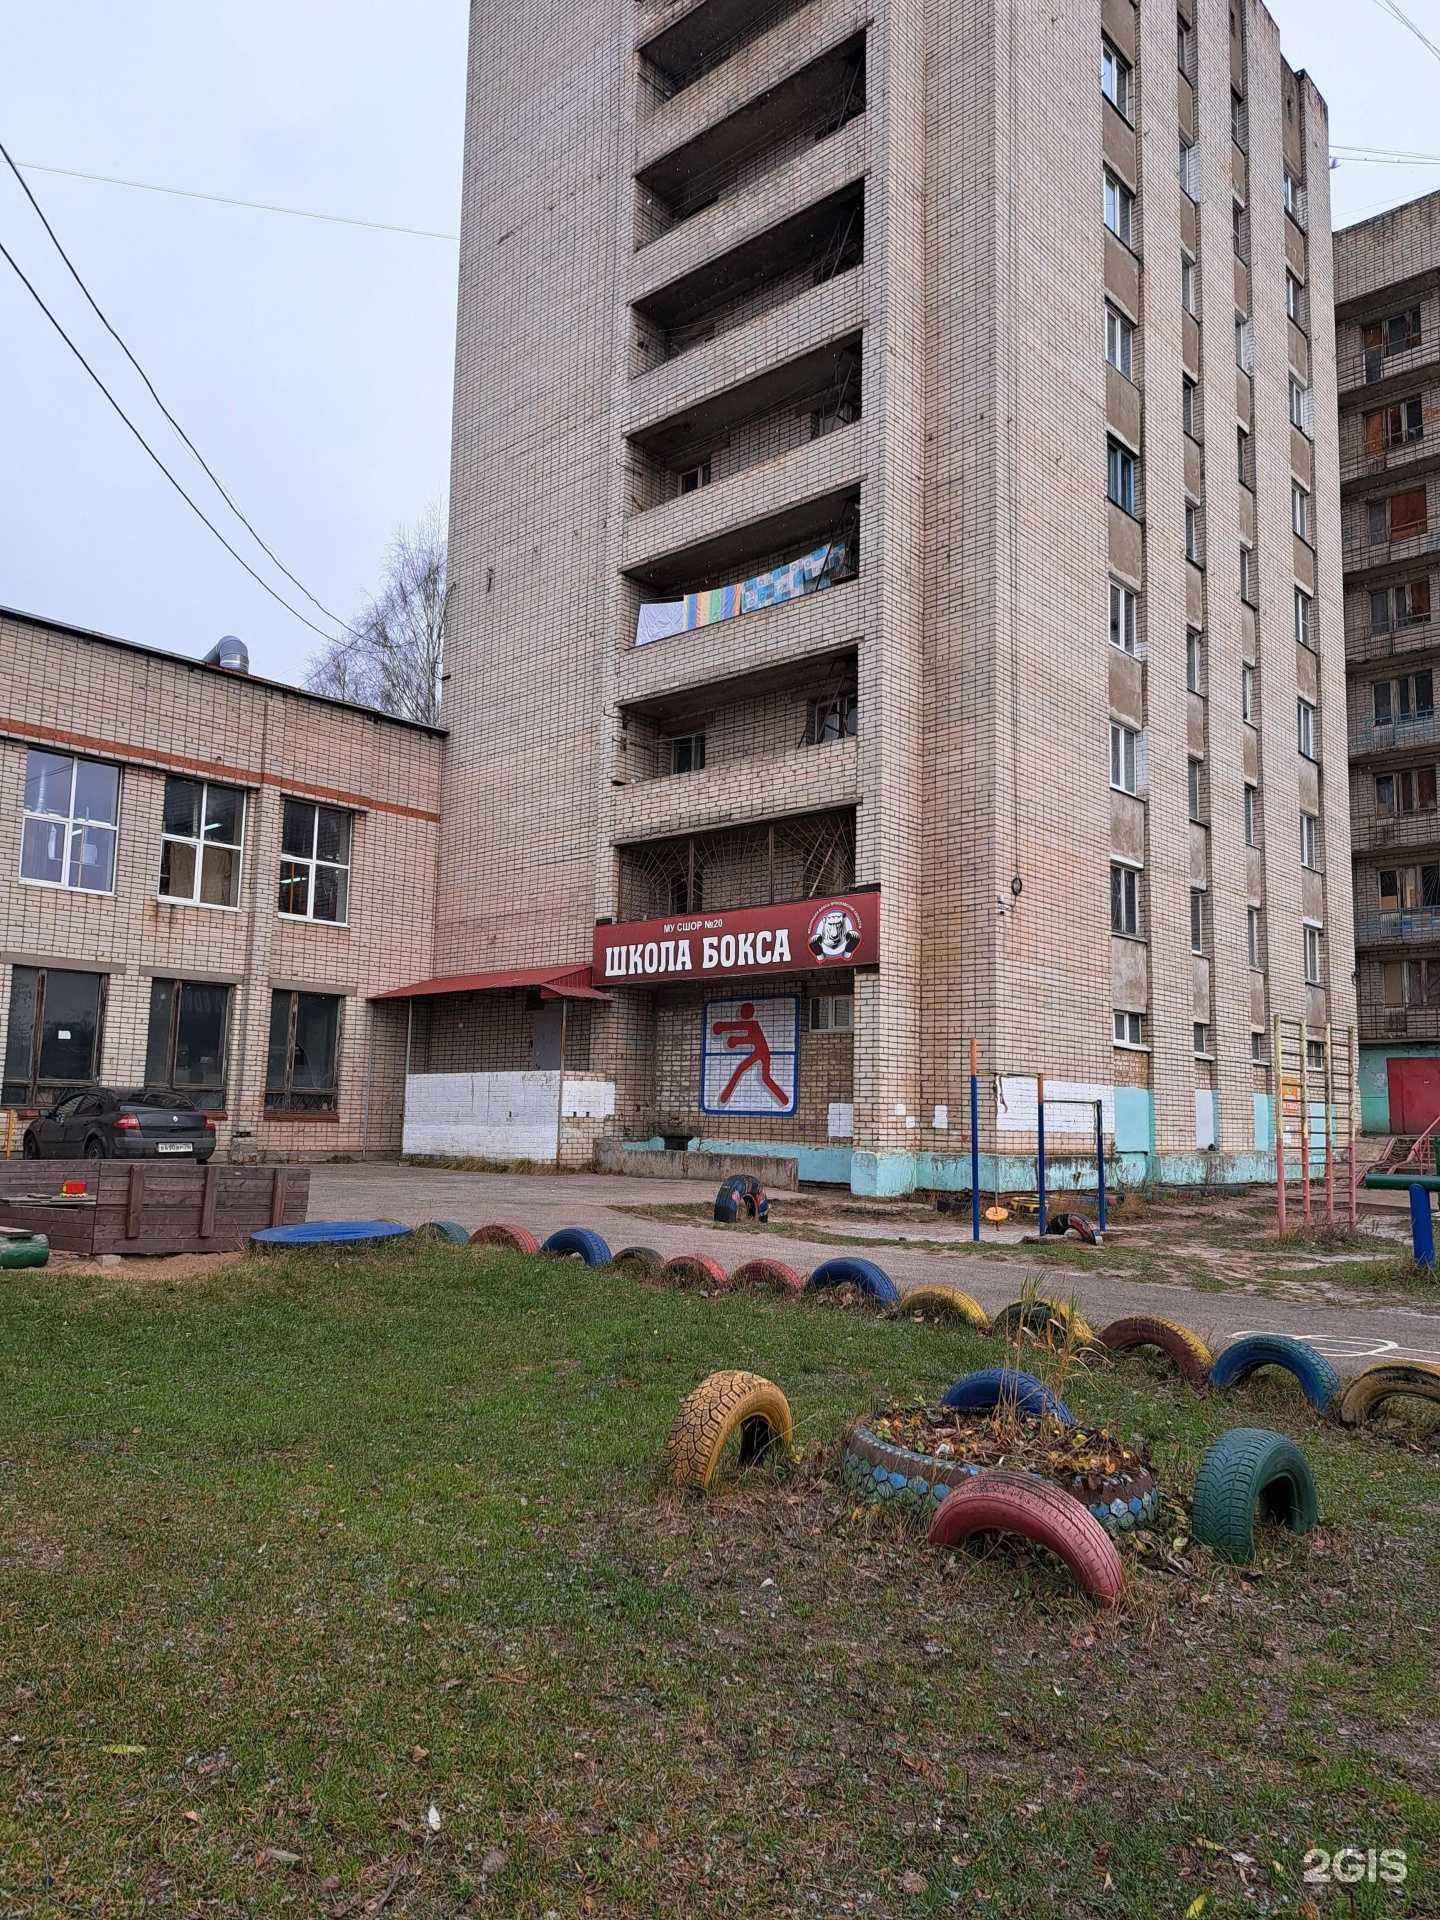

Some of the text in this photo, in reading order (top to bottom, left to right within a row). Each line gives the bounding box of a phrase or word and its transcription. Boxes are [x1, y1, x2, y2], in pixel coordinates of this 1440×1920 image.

[664, 919, 723, 933] МУ СШОР №20
[605, 928, 792, 976] ШКОЛА БОКСА
